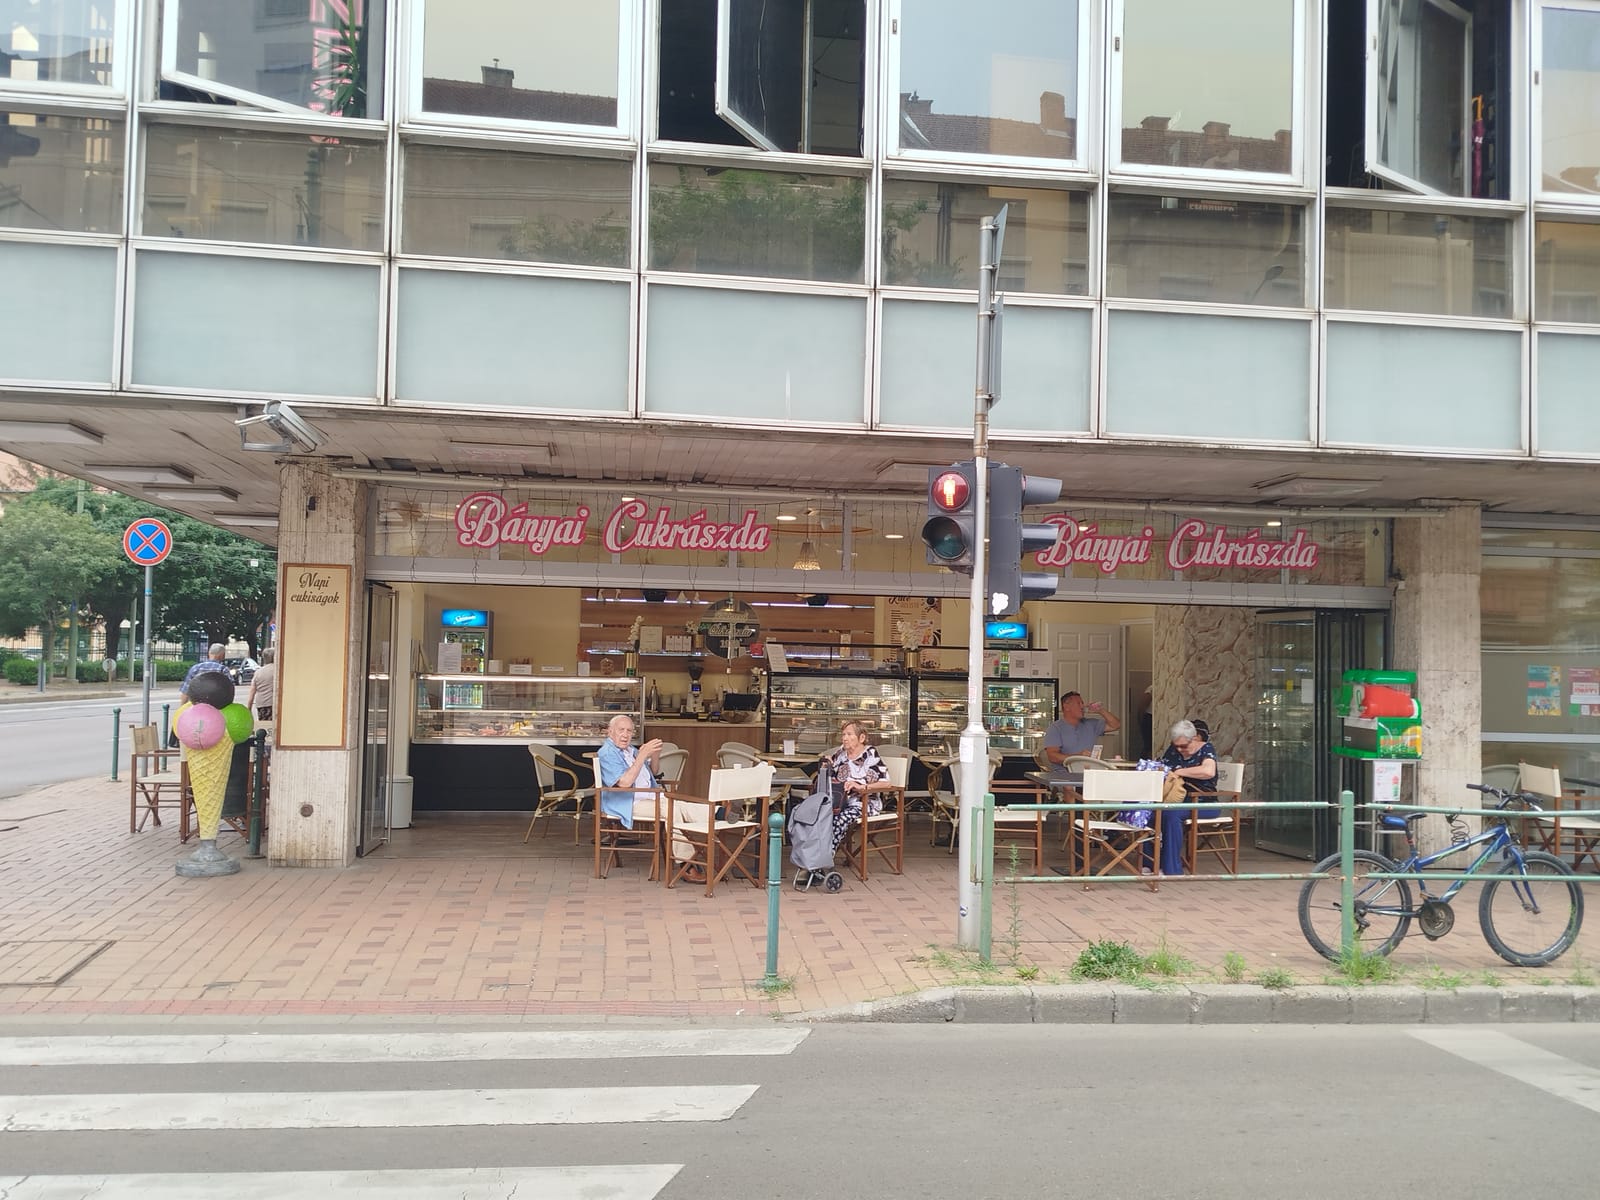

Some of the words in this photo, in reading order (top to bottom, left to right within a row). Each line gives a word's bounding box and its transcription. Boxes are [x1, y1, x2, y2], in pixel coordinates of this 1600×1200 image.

[455, 491, 590, 555] Bányai
[603, 499, 771, 554] Cukrászda
[1035, 514, 1154, 574] Bányai
[1166, 518, 1319, 570] Cukrászda
[290, 590, 340, 606] cukiságok
[299, 572, 331, 590] Napi
